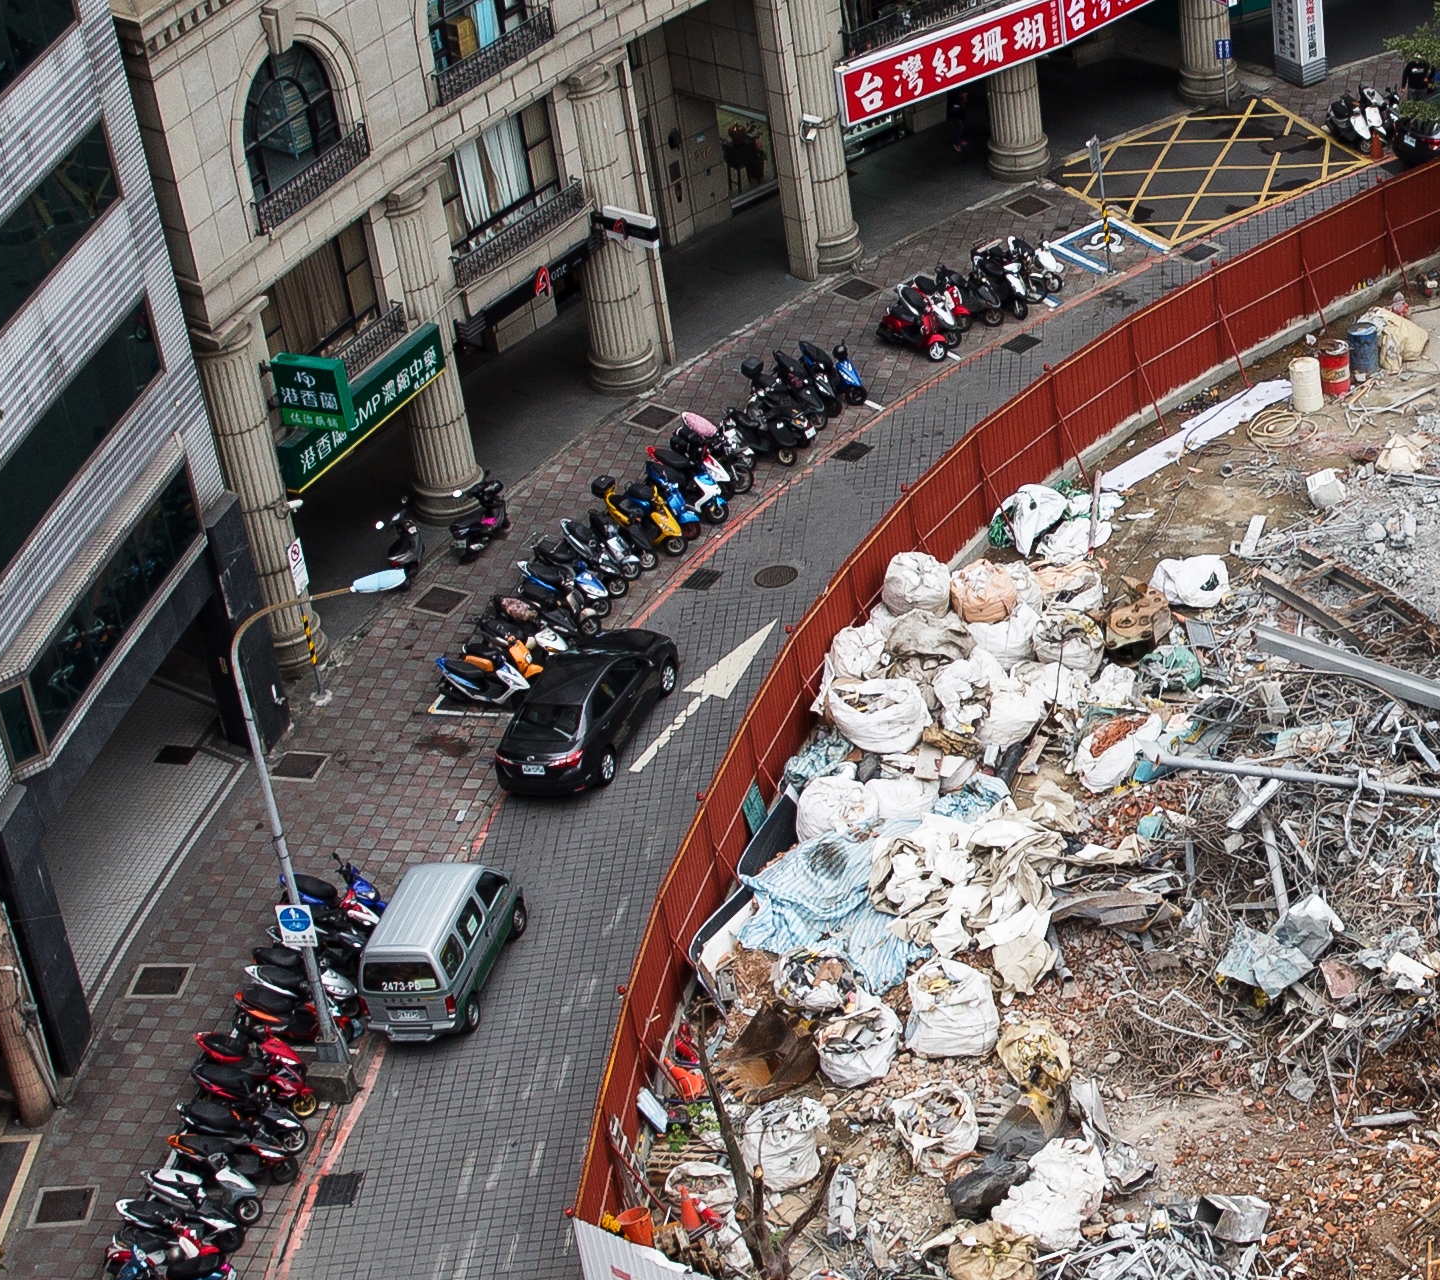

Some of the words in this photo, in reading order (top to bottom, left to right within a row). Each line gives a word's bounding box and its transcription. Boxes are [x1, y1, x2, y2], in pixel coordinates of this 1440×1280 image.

[853, 11, 1048, 115] 台灣紅珊瑚
[279, 386, 339, 412] 港香蘭
